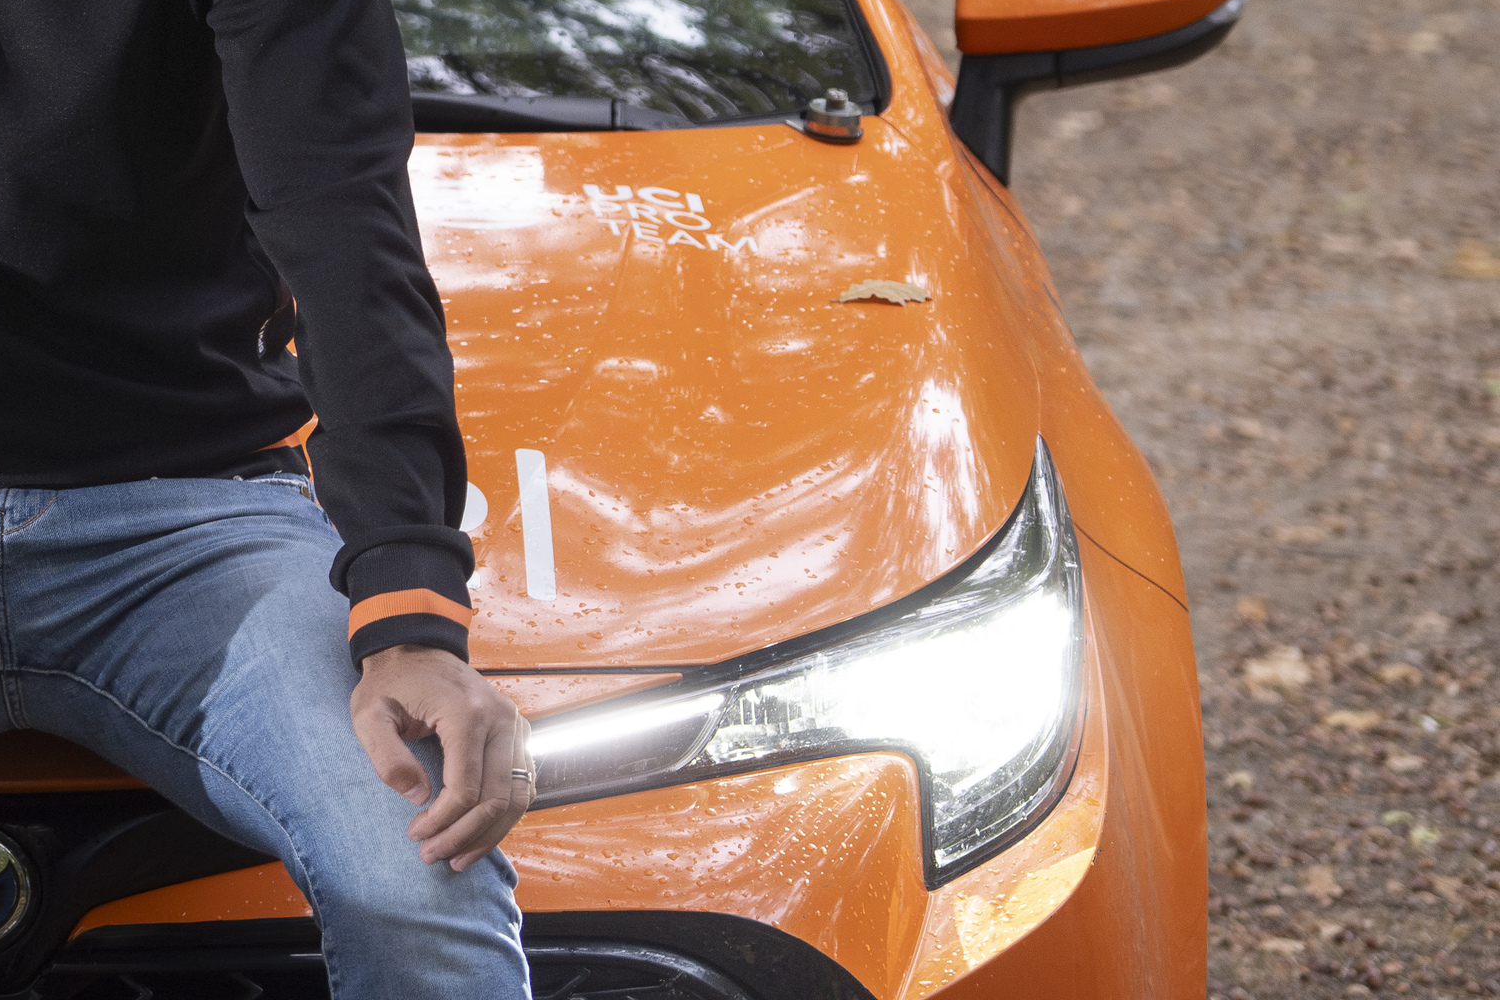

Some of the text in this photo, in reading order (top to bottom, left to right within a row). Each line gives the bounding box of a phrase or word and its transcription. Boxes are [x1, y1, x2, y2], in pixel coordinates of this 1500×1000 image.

[582, 184, 705, 213] UCI
[591, 201, 712, 231] PRO
[598, 219, 759, 252] TEAM
